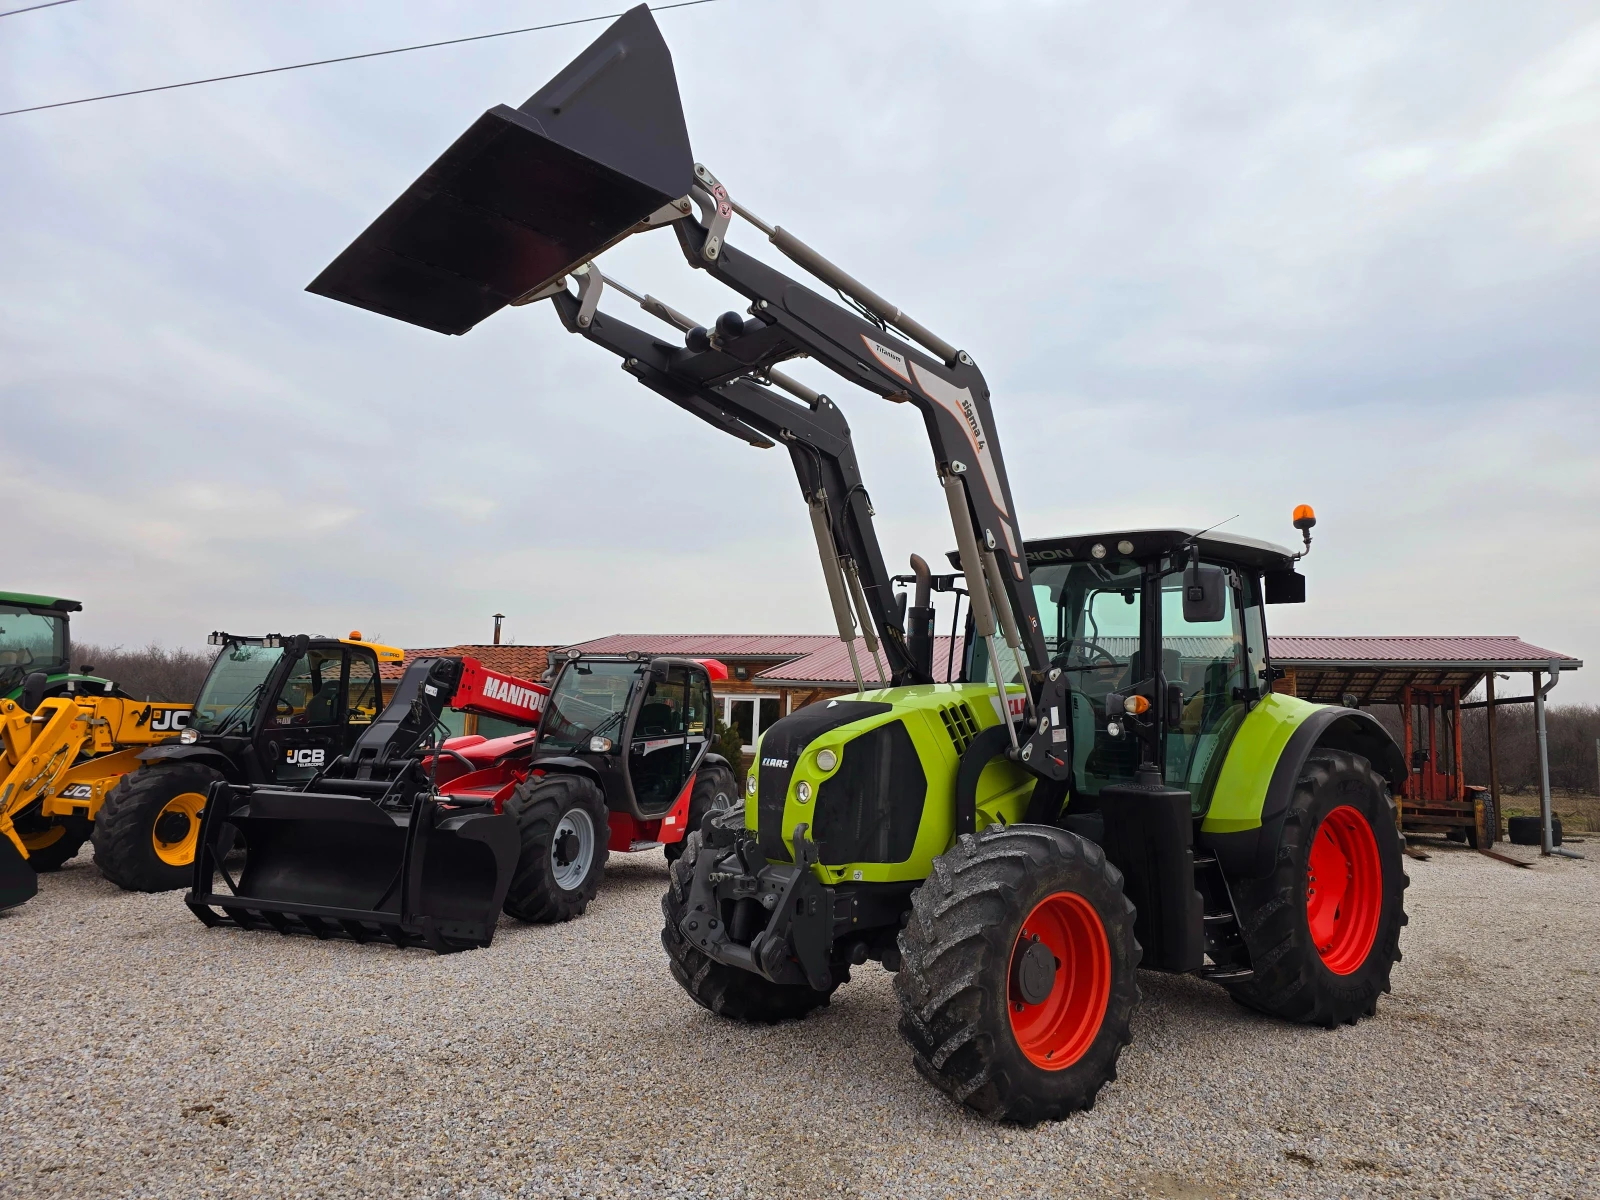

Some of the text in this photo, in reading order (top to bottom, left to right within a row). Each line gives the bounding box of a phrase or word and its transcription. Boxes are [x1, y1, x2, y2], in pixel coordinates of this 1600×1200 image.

[876, 344, 901, 363] Titanium
[962, 400, 986, 450] sigma 4
[1025, 548, 1074, 561] RION
[482, 676, 549, 713] MANITOU
[152, 710, 191, 730] JC
[286, 749, 325, 764] JCB
[761, 757, 789, 769] CLAAS
